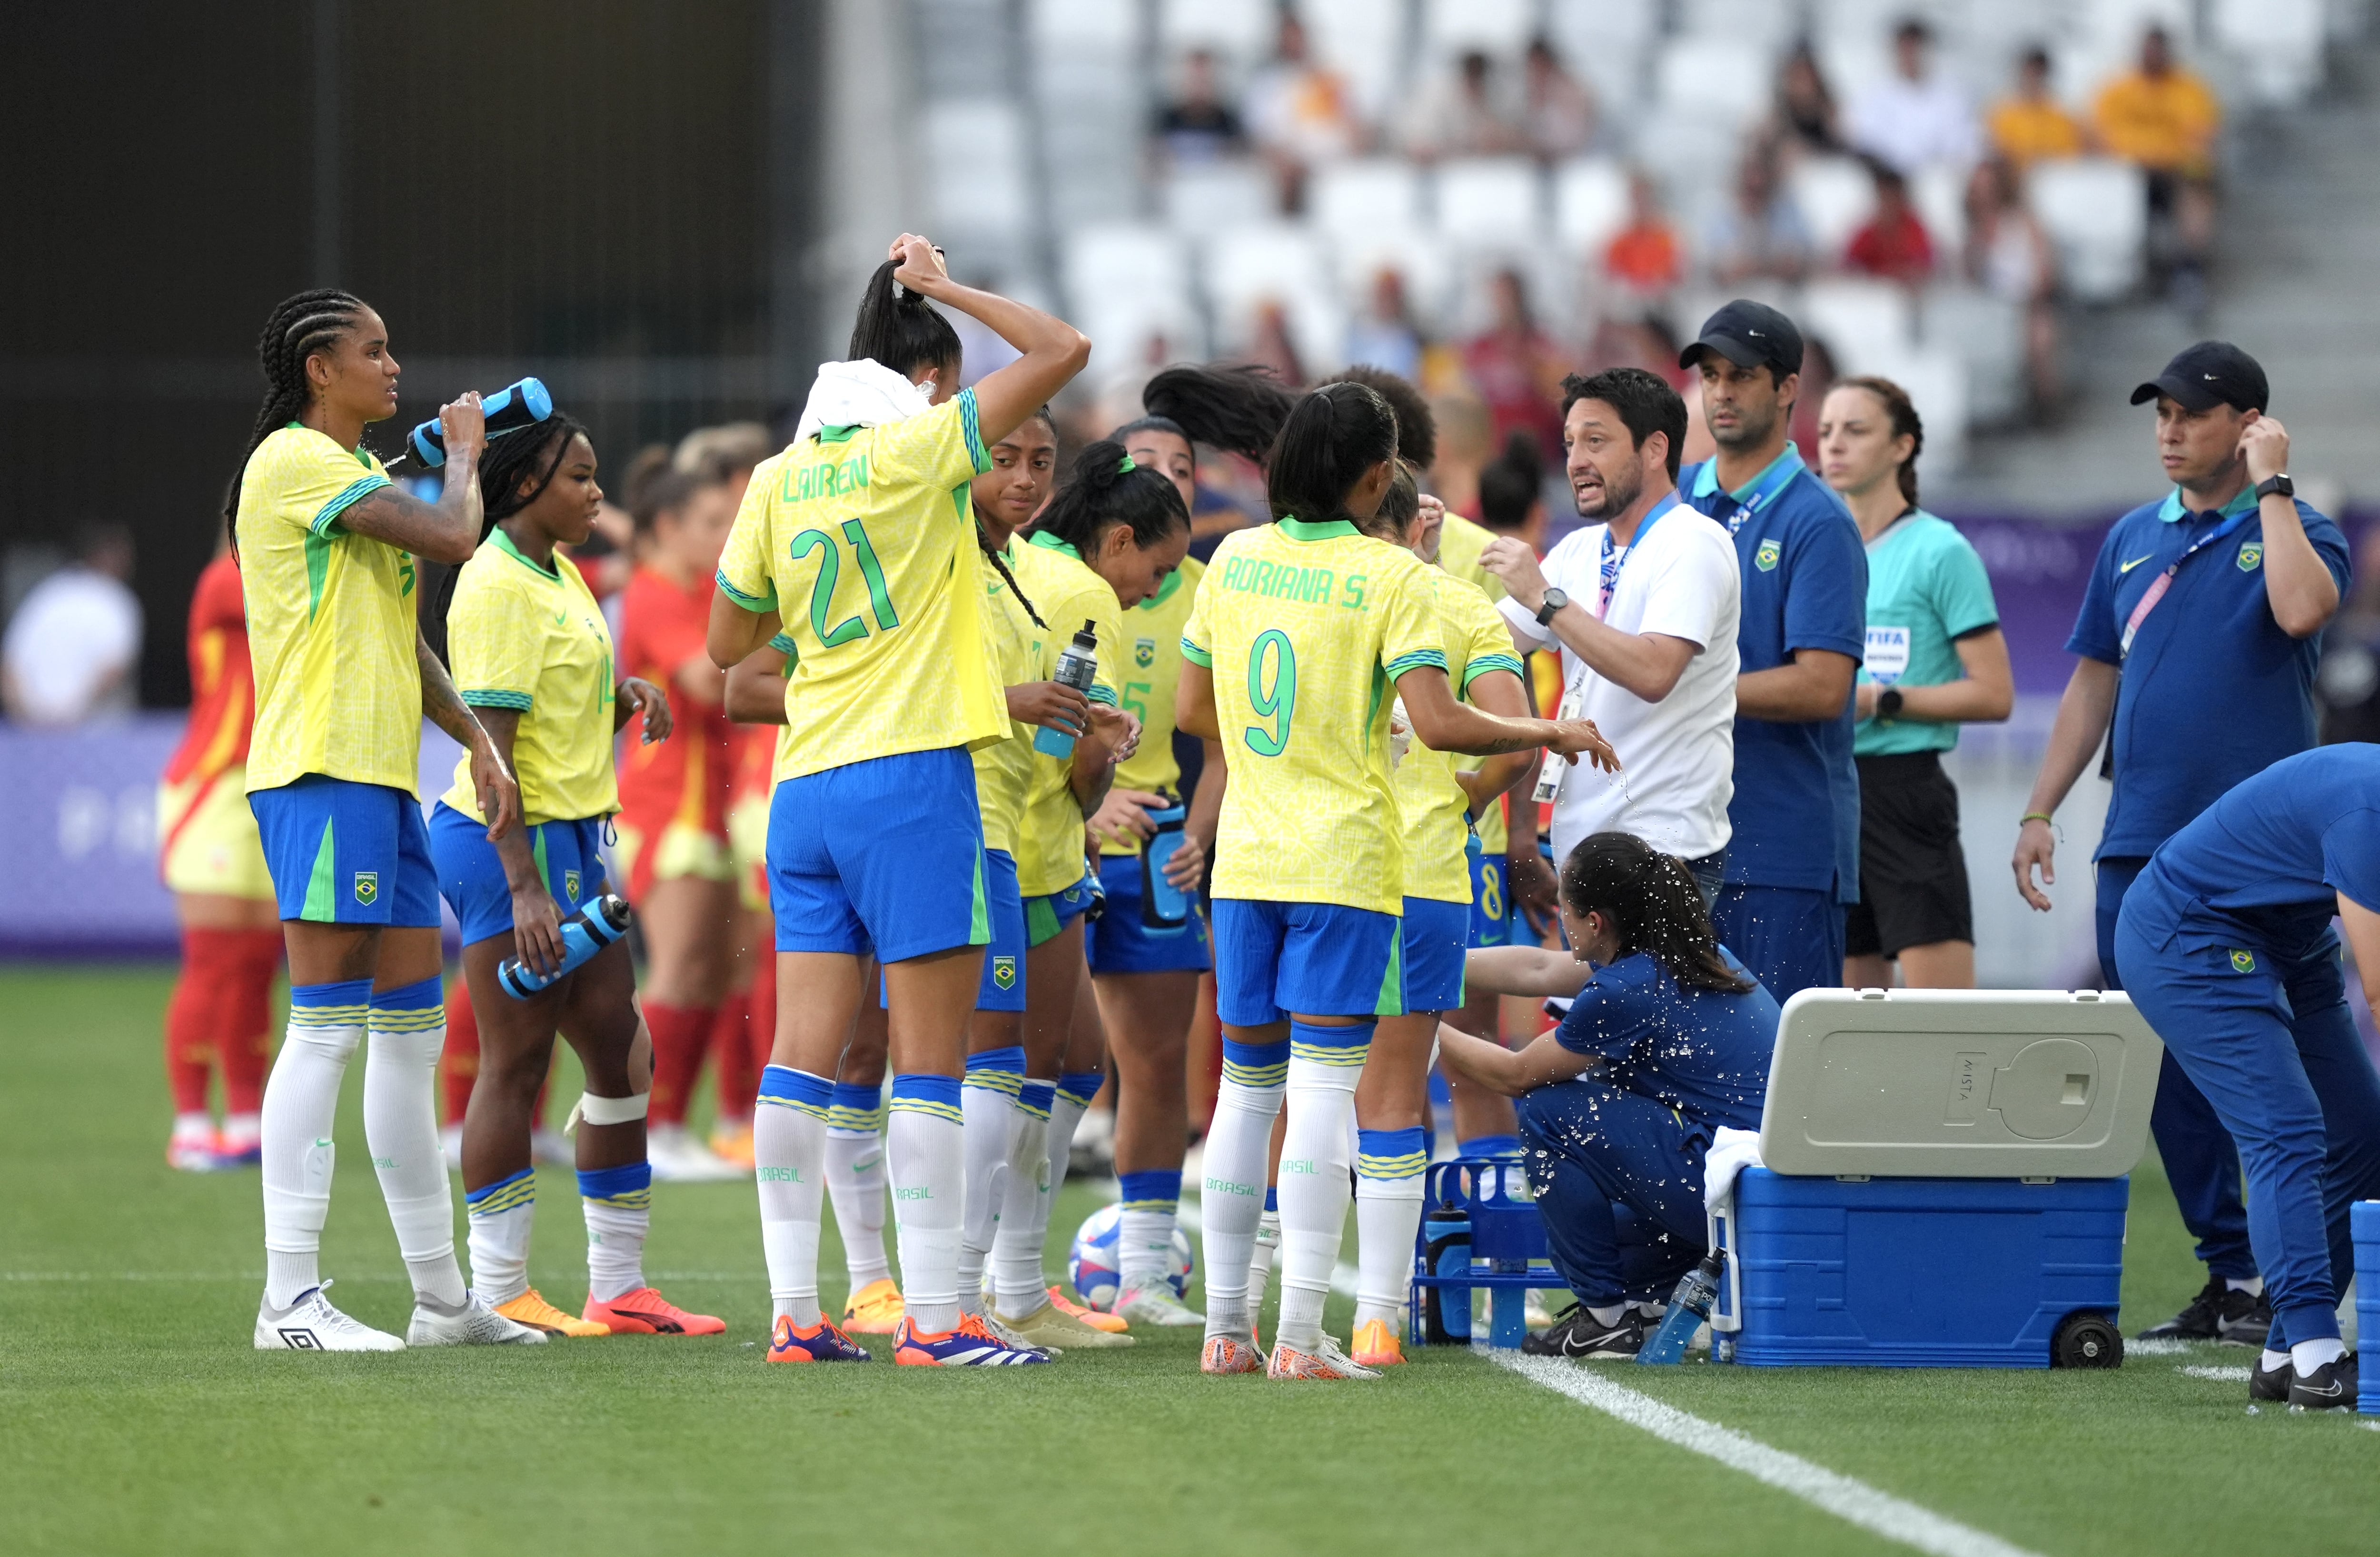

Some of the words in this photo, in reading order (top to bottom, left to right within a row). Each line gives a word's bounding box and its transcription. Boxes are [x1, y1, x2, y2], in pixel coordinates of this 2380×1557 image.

[791, 518, 900, 648] 21
[1222, 555, 1334, 604] ADRIANA
[1341, 575, 1368, 611] S.
[1867, 632, 1904, 645] FIFA
[1245, 629, 1296, 757] 9
[1481, 863, 1503, 921] 8
[1958, 1060, 1973, 1101] MISTA
[758, 1167, 804, 1183] BRASIL
[1206, 1178, 1258, 1196] BRASIL
